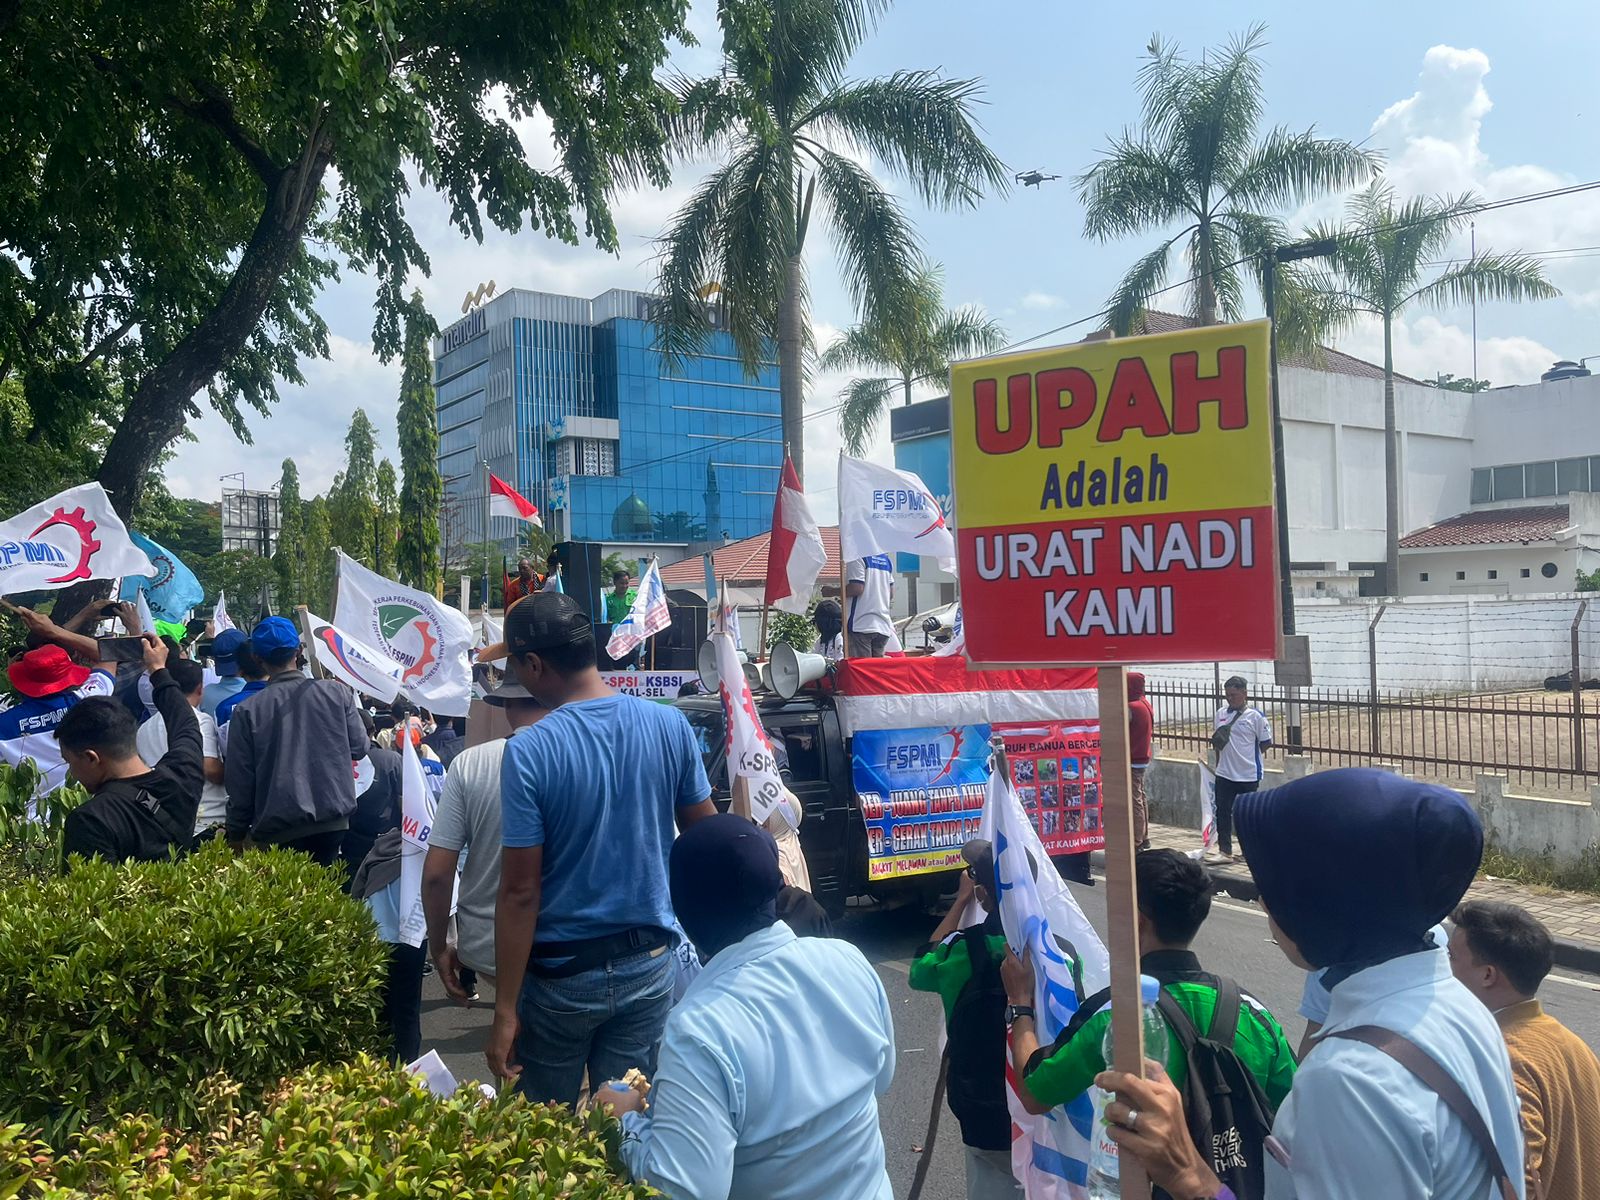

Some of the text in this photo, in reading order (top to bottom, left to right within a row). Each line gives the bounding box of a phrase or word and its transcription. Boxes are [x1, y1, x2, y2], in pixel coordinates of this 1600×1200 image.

[443, 308, 486, 353] mandiri
[973, 345, 1249, 455] UPAH
[1040, 453, 1169, 510] Adalah
[0, 541, 66, 565] PMI
[975, 517, 1254, 581] URAT NADI
[1044, 585, 1173, 637] KAMI
[646, 676, 682, 687] KSBSI
[886, 743, 940, 770] FSPMI
[1029, 741, 1066, 752] BANUA
